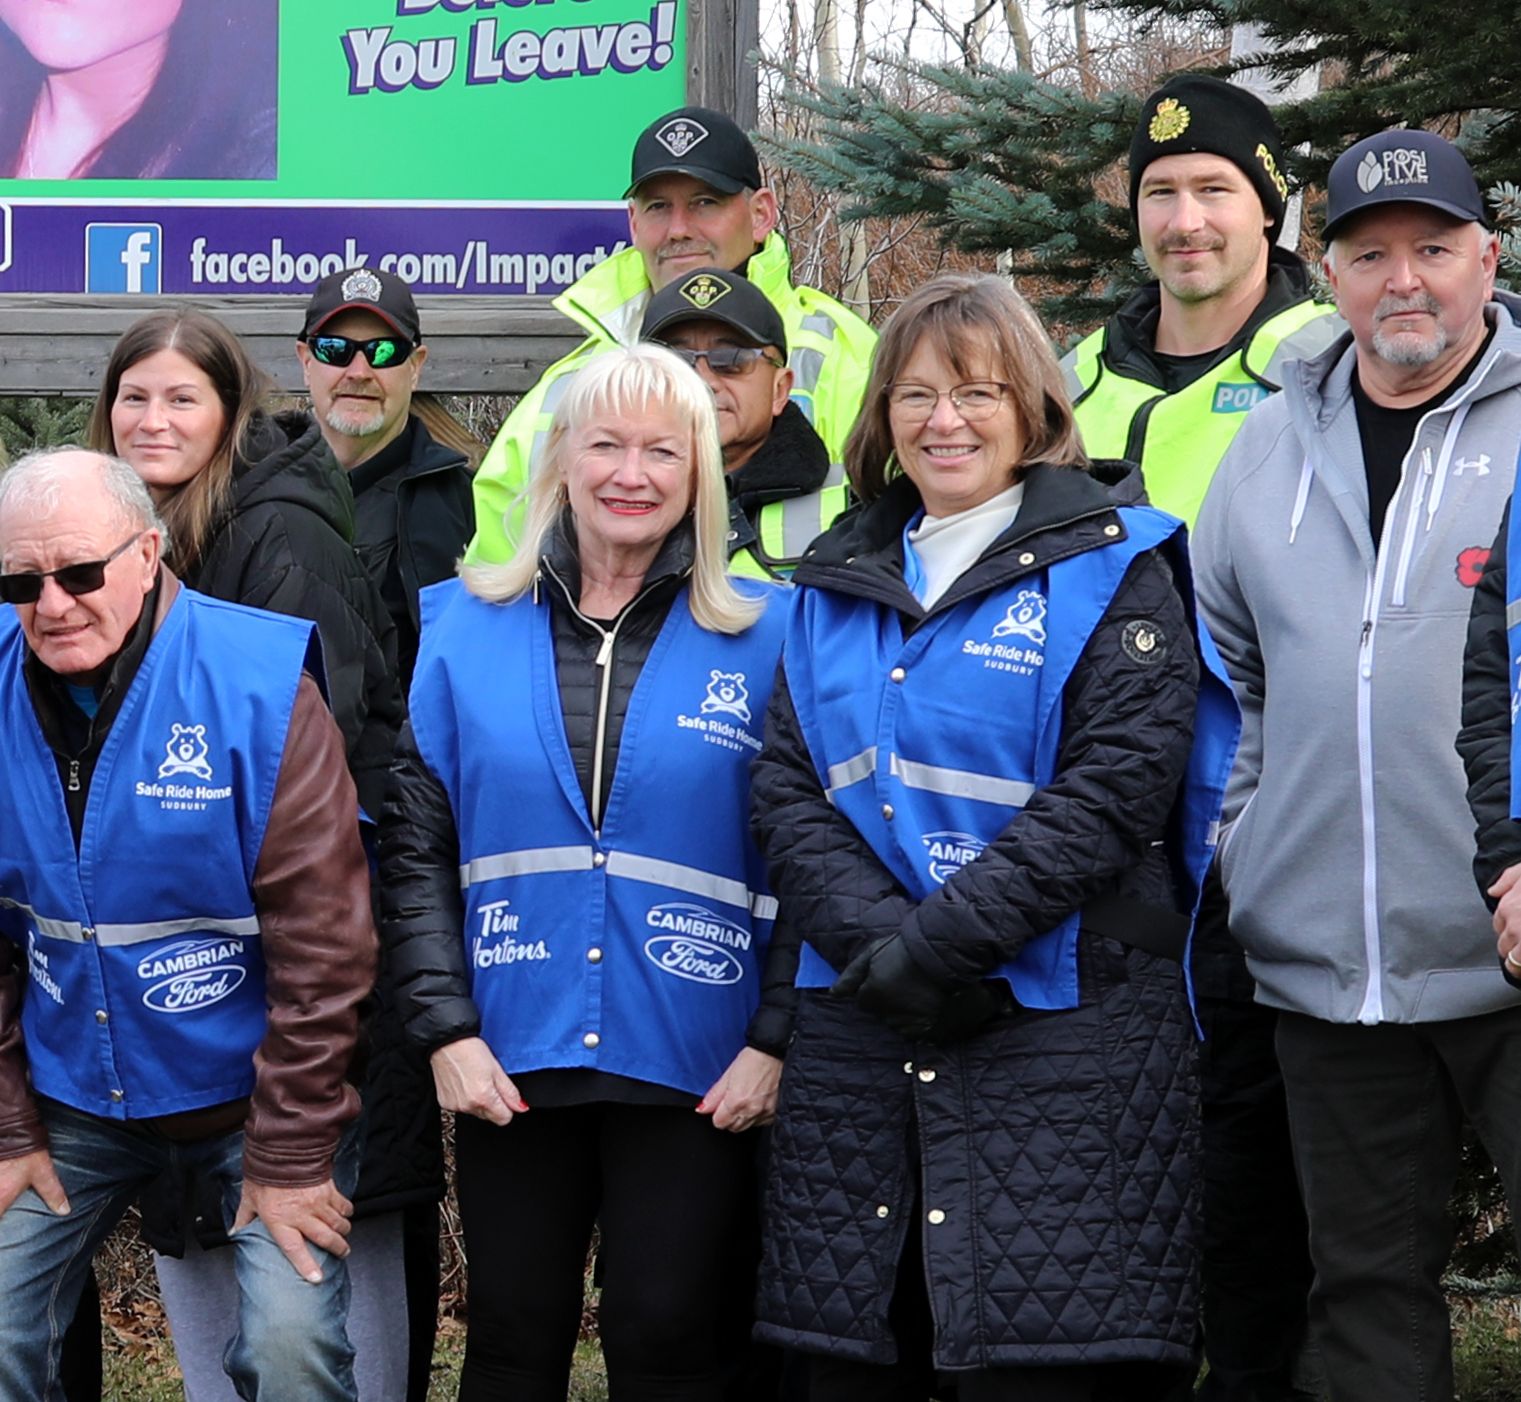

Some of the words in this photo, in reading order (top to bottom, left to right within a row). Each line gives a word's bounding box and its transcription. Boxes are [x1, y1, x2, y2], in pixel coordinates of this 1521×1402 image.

[341, 26, 456, 95] You
[466, 0, 677, 85] Leave!
[962, 639, 992, 658] Safe
[992, 645, 1023, 662] Ride
[983, 658, 1036, 677] SUDBURY
[676, 714, 708, 731] Safe
[708, 719, 736, 738] Ride
[736, 727, 764, 752] Home
[703, 733, 744, 753] SUDBURY
[135, 781, 164, 797] Safe
[165, 784, 194, 799] Ride
[195, 785, 232, 799] Home
[160, 800, 207, 811] SUDBURY
[477, 900, 520, 937] Tim
[646, 909, 752, 951] CAMBRIAN
[137, 941, 245, 979] CAMBRIAN
[662, 939, 729, 980] Ford
[164, 972, 228, 1008] Ford
